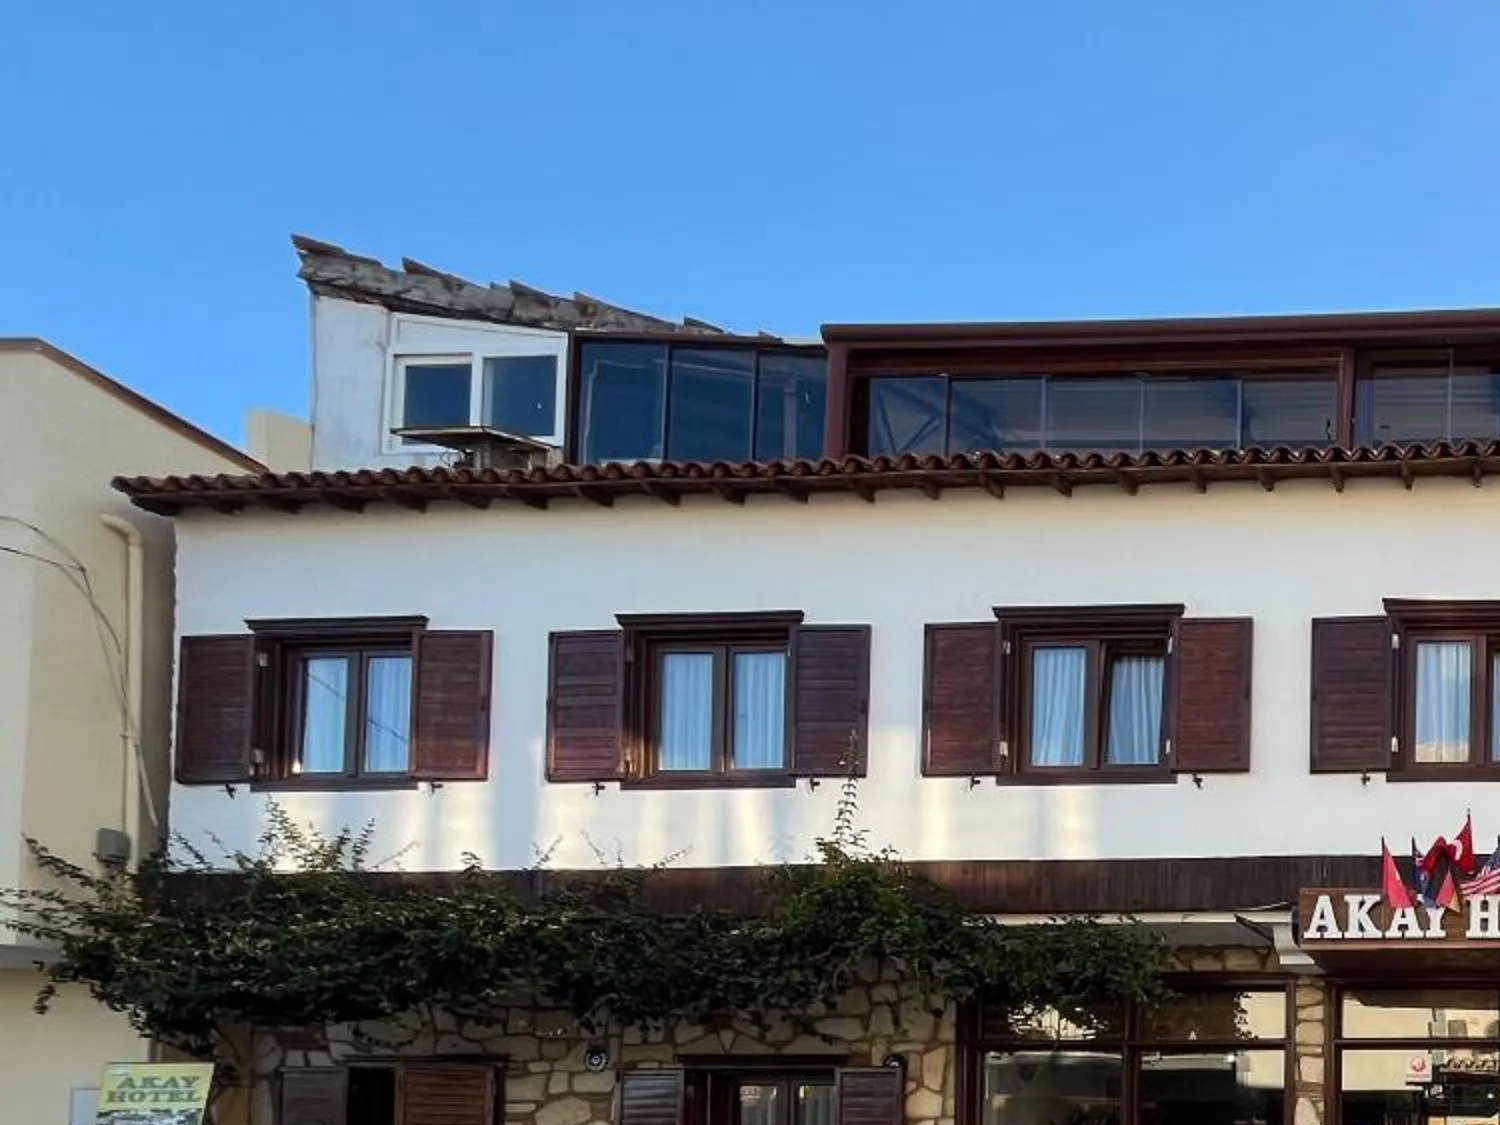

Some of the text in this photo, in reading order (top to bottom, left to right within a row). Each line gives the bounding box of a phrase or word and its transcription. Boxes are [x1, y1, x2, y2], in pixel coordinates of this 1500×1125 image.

[1304, 894, 1447, 939] AKAY
[117, 1076, 200, 1089] AKAY
[107, 1089, 201, 1102] HOTEL
